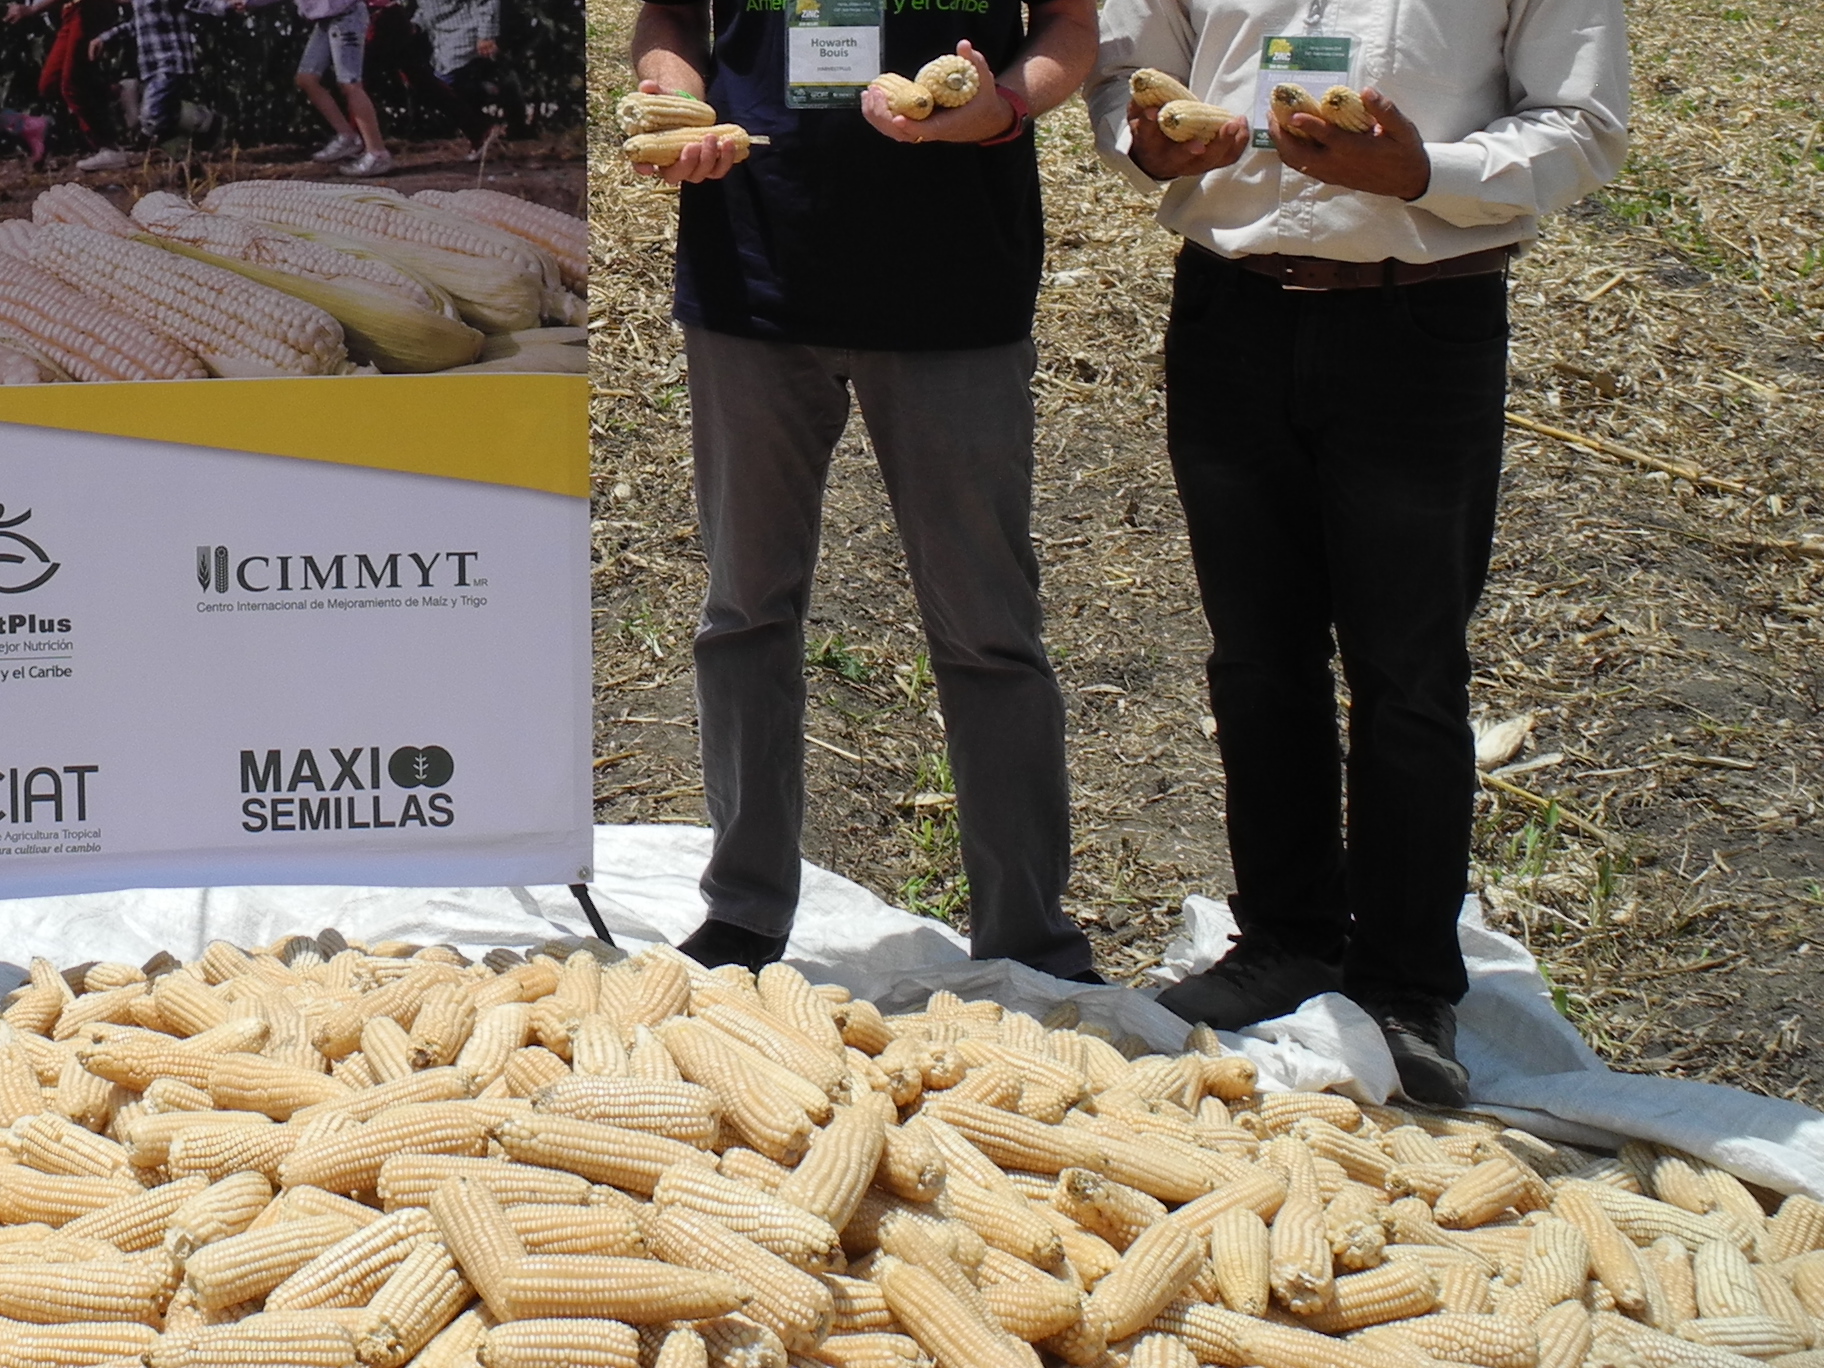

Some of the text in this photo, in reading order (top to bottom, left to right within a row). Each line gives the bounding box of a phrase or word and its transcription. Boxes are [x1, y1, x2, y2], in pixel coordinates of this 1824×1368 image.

[811, 38, 857, 48] Howarth
[819, 48, 849, 57] Bouis
[236, 552, 478, 592] CIMMYT
[196, 595, 487, 613] Centro Internacional de Mejoramiento de Maíz y Trigo
[23, 638, 73, 651] Nutrición
[1, 668, 9, 682] y
[12, 666, 25, 679] el
[28, 665, 72, 678] Caribe
[240, 747, 380, 793] MAXI
[241, 793, 454, 832] SEMILLAS
[4, 830, 59, 843] Agricultura
[62, 828, 101, 841] Tropical
[14, 845, 51, 855] cultivar
[53, 844, 63, 854] el
[65, 843, 101, 853] cambio
